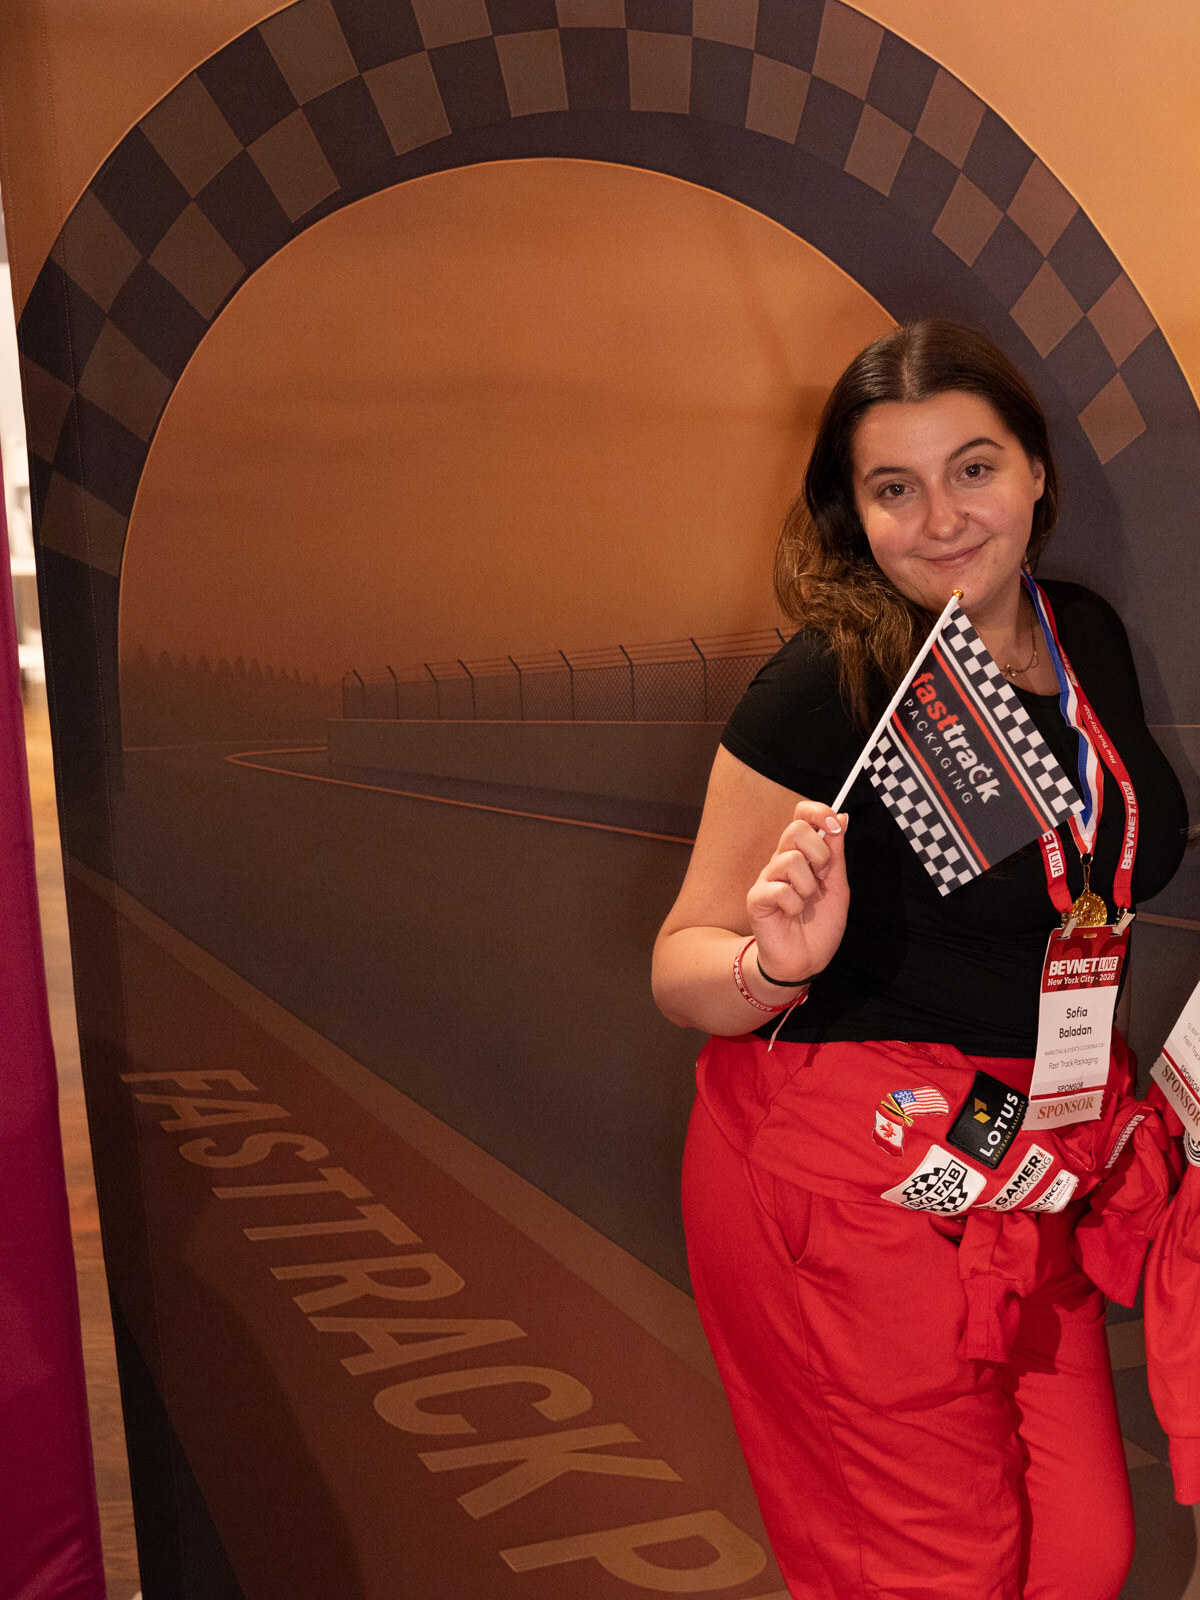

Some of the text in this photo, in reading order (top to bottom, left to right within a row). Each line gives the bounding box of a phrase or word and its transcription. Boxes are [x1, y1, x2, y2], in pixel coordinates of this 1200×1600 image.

[904, 698, 973, 804] PACKAGING
[1047, 849, 1064, 878] LIVE
[1098, 956, 1119, 972] LIVE
[1047, 973, 1115, 987] New York City 2026
[1066, 1006, 1088, 1019] Sofia
[1059, 1025, 1092, 1039] Baladan
[1060, 1060, 1074, 1068] Track
[1074, 1056, 1098, 1067] Packaging
[1057, 1082, 1084, 1093] SPONSOR
[1180, 1064, 1200, 1093] SPONSOR
[1011, 1101, 1025, 1129] ALLIANCE
[1037, 1096, 1094, 1120] SPONSOR
[979, 1093, 1018, 1157] LOTUS
[909, 1168, 961, 1208] SKA FAB
[995, 1155, 1042, 1206] GAMER
[1001, 1156, 1052, 1210] PACKAGING
[500, 1510, 768, 1592] P
